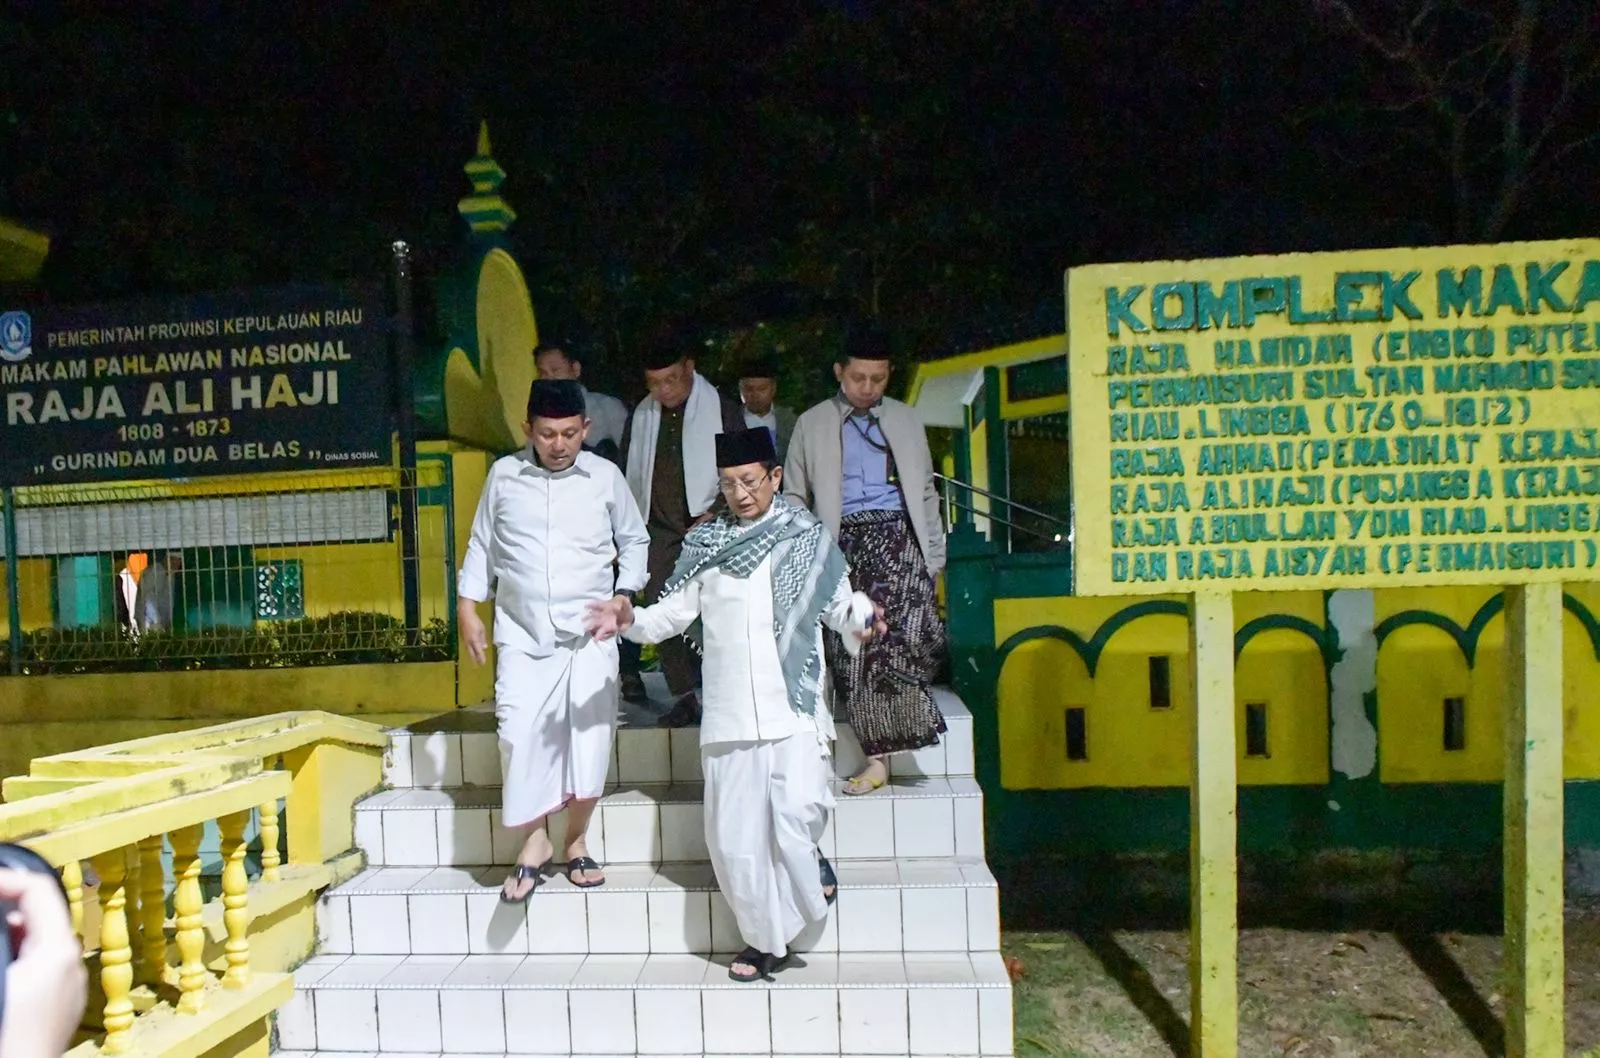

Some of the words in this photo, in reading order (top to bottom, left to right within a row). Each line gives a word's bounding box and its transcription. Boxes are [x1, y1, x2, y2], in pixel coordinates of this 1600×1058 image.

[1105, 271, 1424, 338] KOMPLEK
[1437, 259, 1600, 318] MAKA
[48, 327, 145, 348] PEMERINTAH
[150, 319, 219, 342] PROVINSI
[224, 312, 320, 334] KEPULAUAN
[325, 309, 362, 327] RIAU
[1, 358, 87, 385] MAKAM
[94, 349, 222, 377] PAHLAWAN
[231, 340, 351, 368] NASIONAL
[1107, 343, 1190, 376] RAJA
[1507, 322, 1600, 356] PUTE
[7, 384, 126, 426] RAJA
[141, 378, 214, 416] ALI
[230, 370, 339, 411] HAJI
[1108, 372, 1294, 409] PERMAISURI
[117, 422, 164, 442] 1808
[188, 418, 231, 438] 1873
[51, 449, 166, 471] GURINDAM
[173, 444, 218, 464] DUA
[228, 440, 300, 461] BELAS
[325, 452, 349, 462] DINAS
[350, 450, 379, 461] SOSIAL
[1110, 447, 1185, 478] RAJA
[1110, 482, 1190, 514] RAJA
[1111, 517, 1180, 547] RAJA
[1111, 551, 1168, 582] DAN
[1176, 548, 1254, 580] RAJA
[1263, 545, 1367, 577] AISYAH
